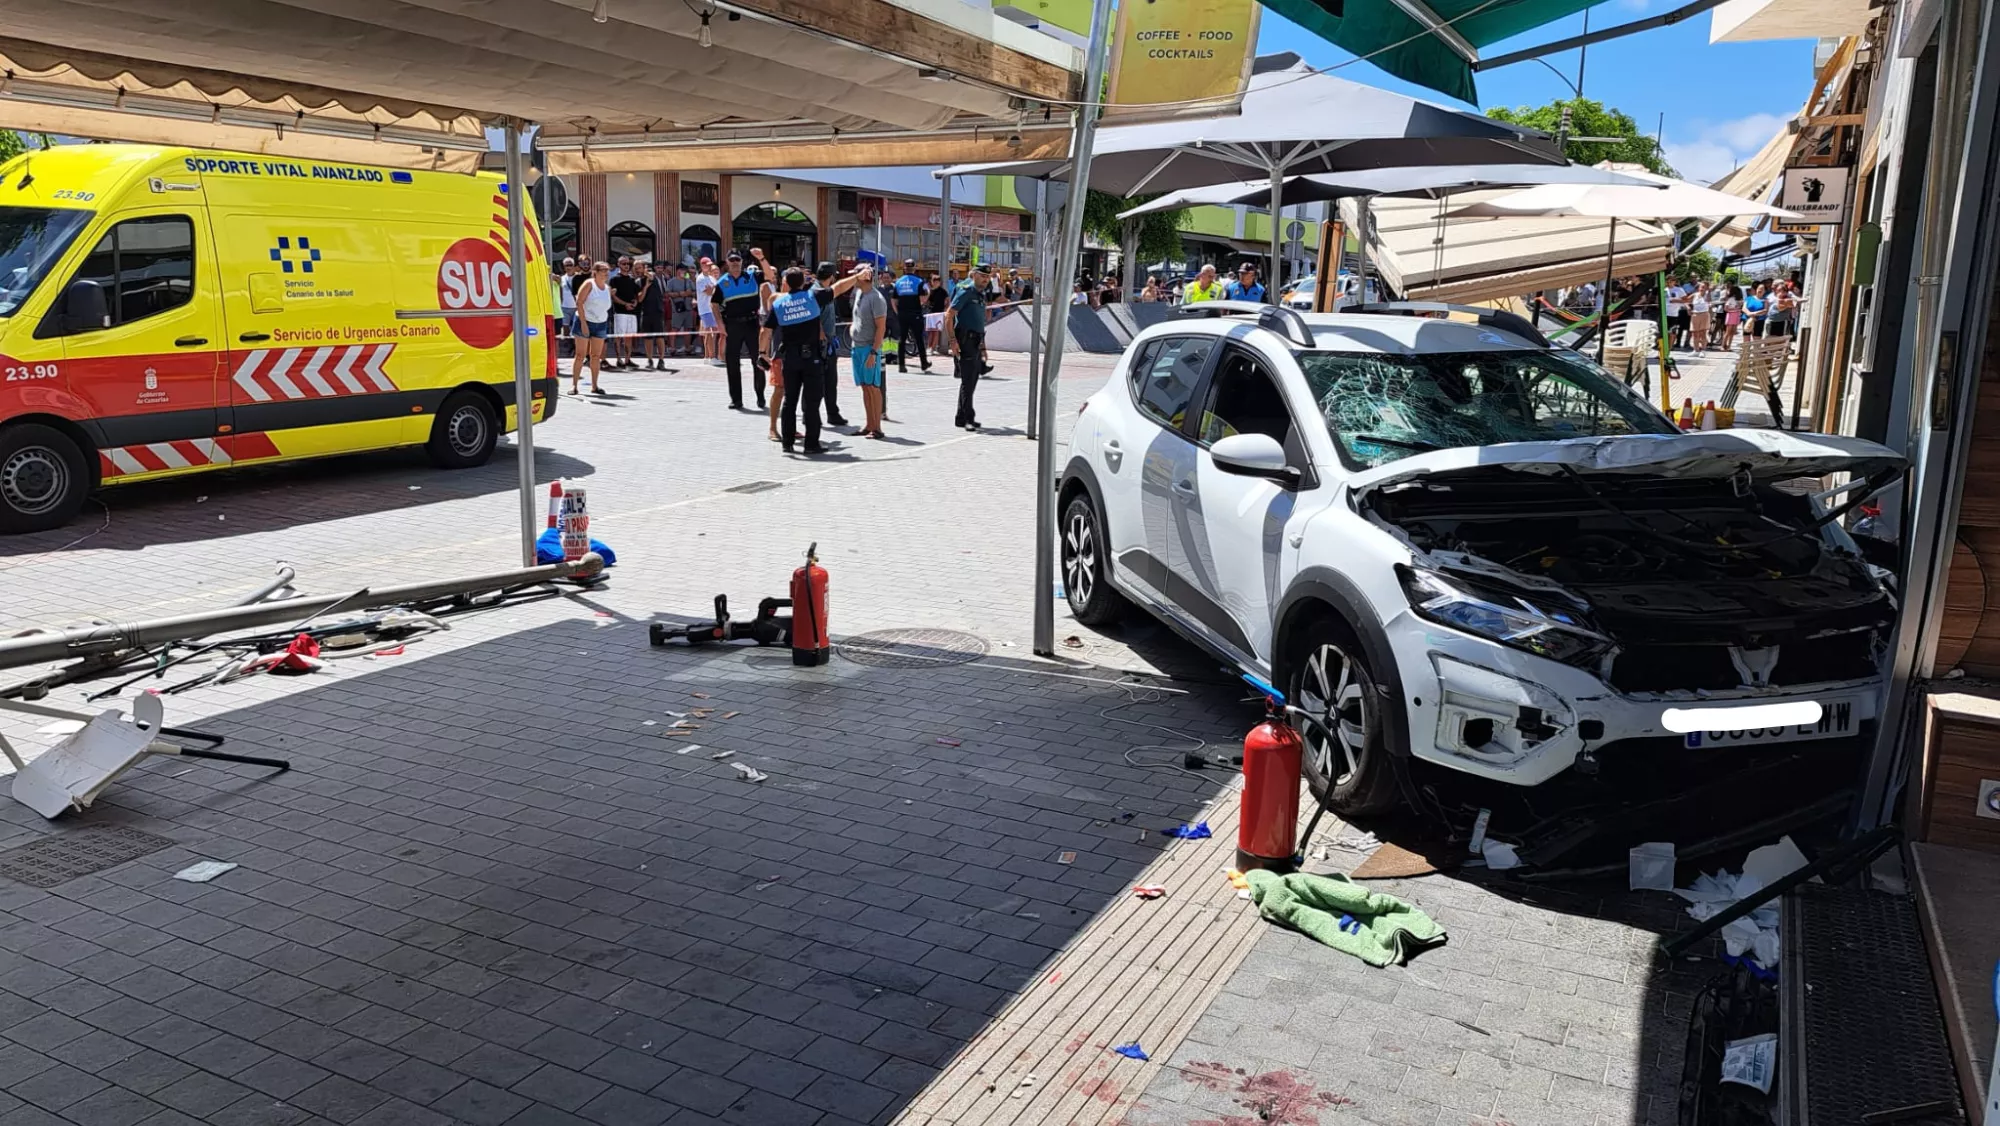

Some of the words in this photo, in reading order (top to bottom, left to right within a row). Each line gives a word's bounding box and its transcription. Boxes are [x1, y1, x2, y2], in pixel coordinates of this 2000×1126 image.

[1136, 31, 1180, 41] COFFEE
[1199, 31, 1233, 41] FOOD
[1148, 49, 1214, 59] COCKTAILS
[185, 158, 261, 175] SOPORTE
[264, 162, 308, 177] VITAL
[312, 166, 383, 182] AVANZADO
[53, 190, 95, 201] 23.90
[1785, 203, 1840, 211] HAUSBRANDT
[441, 260, 513, 308] SUC
[286, 290, 314, 298] Canario
[334, 289, 354, 297] Salud
[783, 310, 811, 321] CANARIA
[785, 306, 806, 314] LOCAL
[273, 328, 322, 341] Servicio
[326, 327, 340, 340] de
[343, 325, 398, 342] Urgencias
[400, 324, 440, 337] Canario
[5, 364, 58, 381] 23.90
